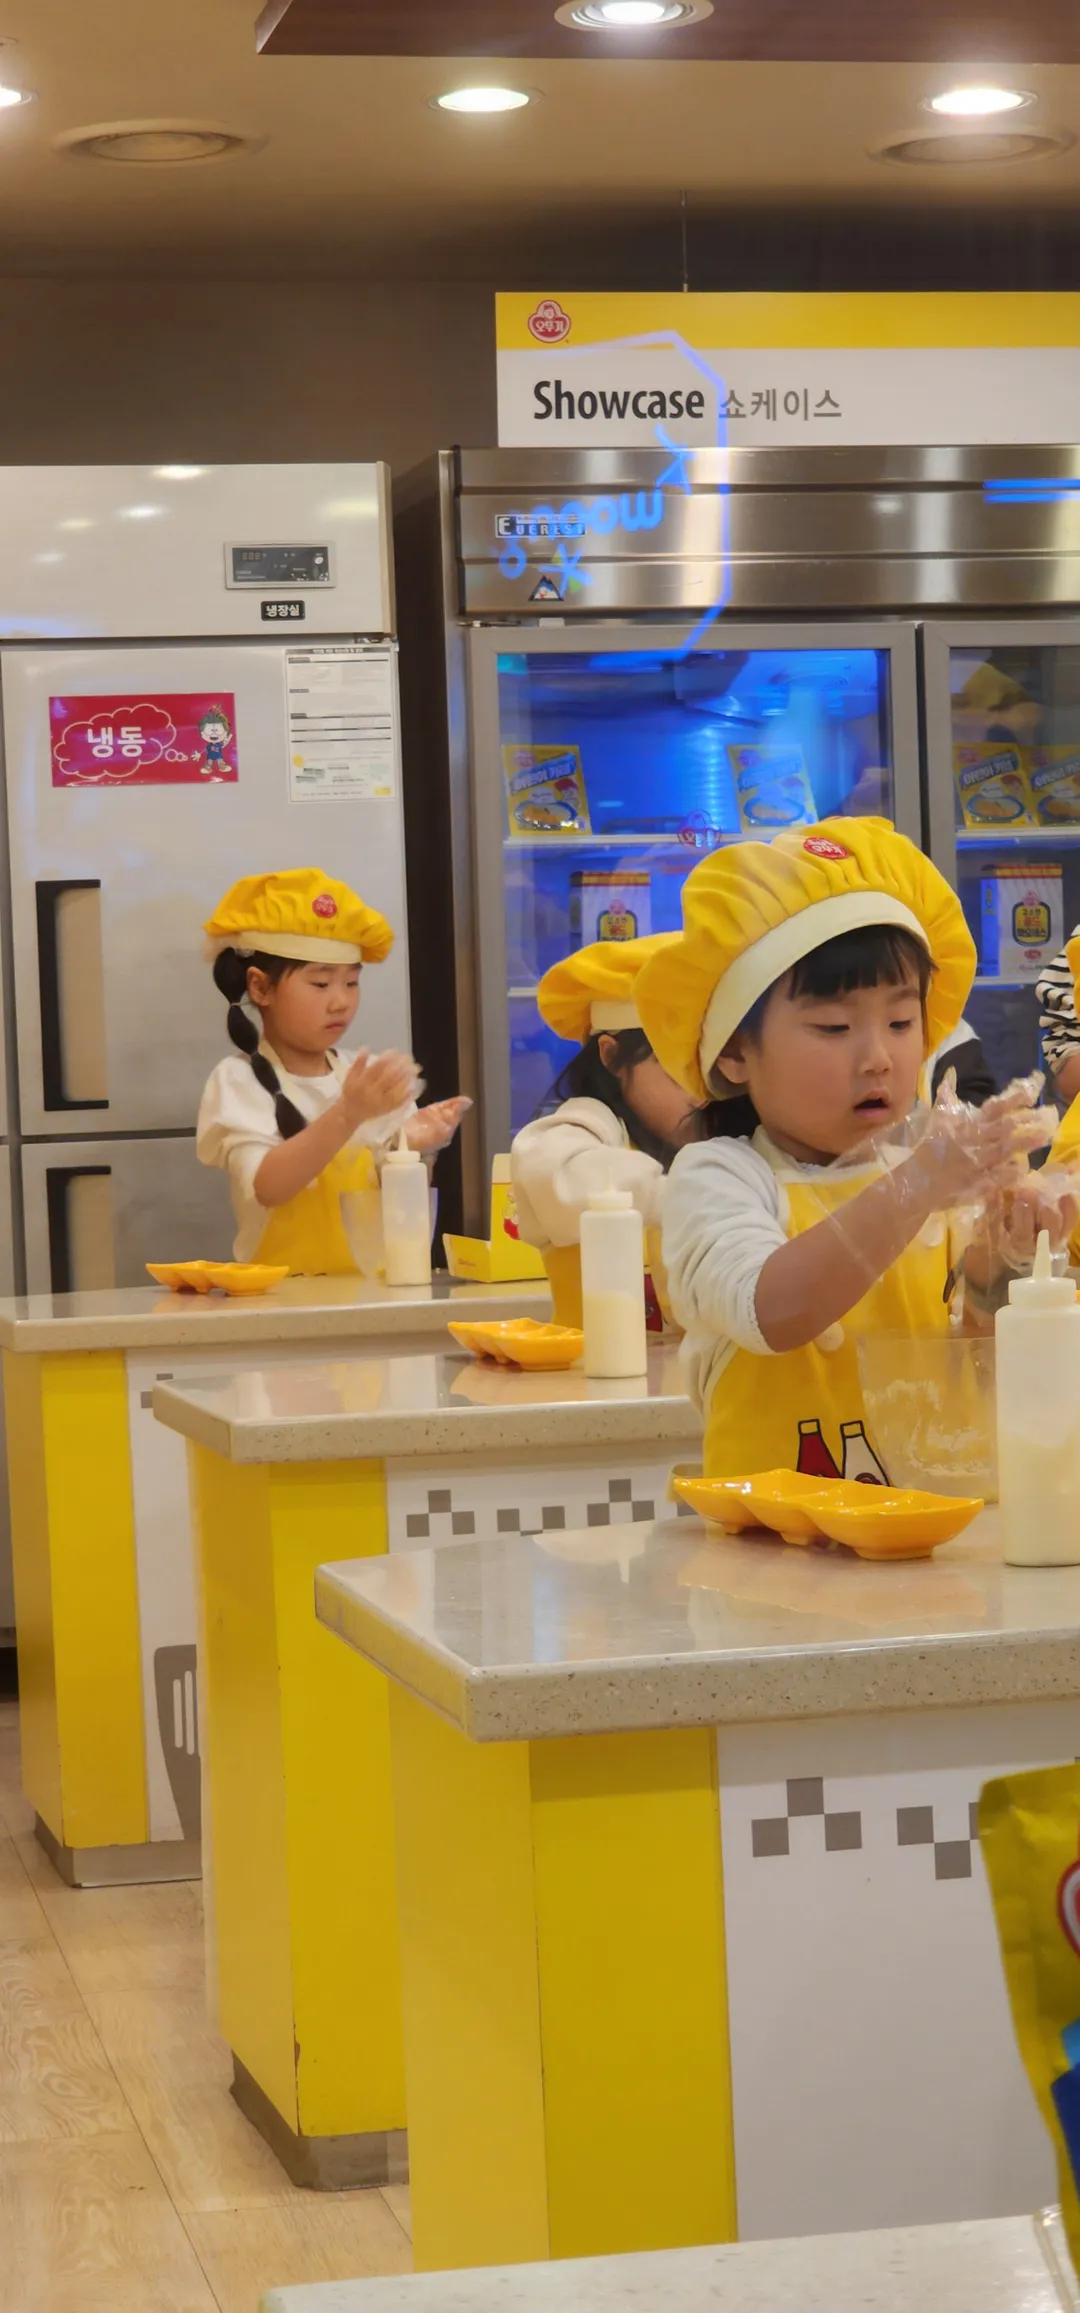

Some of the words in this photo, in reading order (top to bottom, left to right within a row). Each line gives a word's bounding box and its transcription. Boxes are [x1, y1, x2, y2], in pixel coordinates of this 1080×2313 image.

[535, 319, 565, 333] 오뚜기
[533, 380, 704, 420] Showcase
[719, 388, 842, 421] 쇼케이스
[265, 604, 301, 618] 냉장실
[87, 726, 147, 758] 냉동
